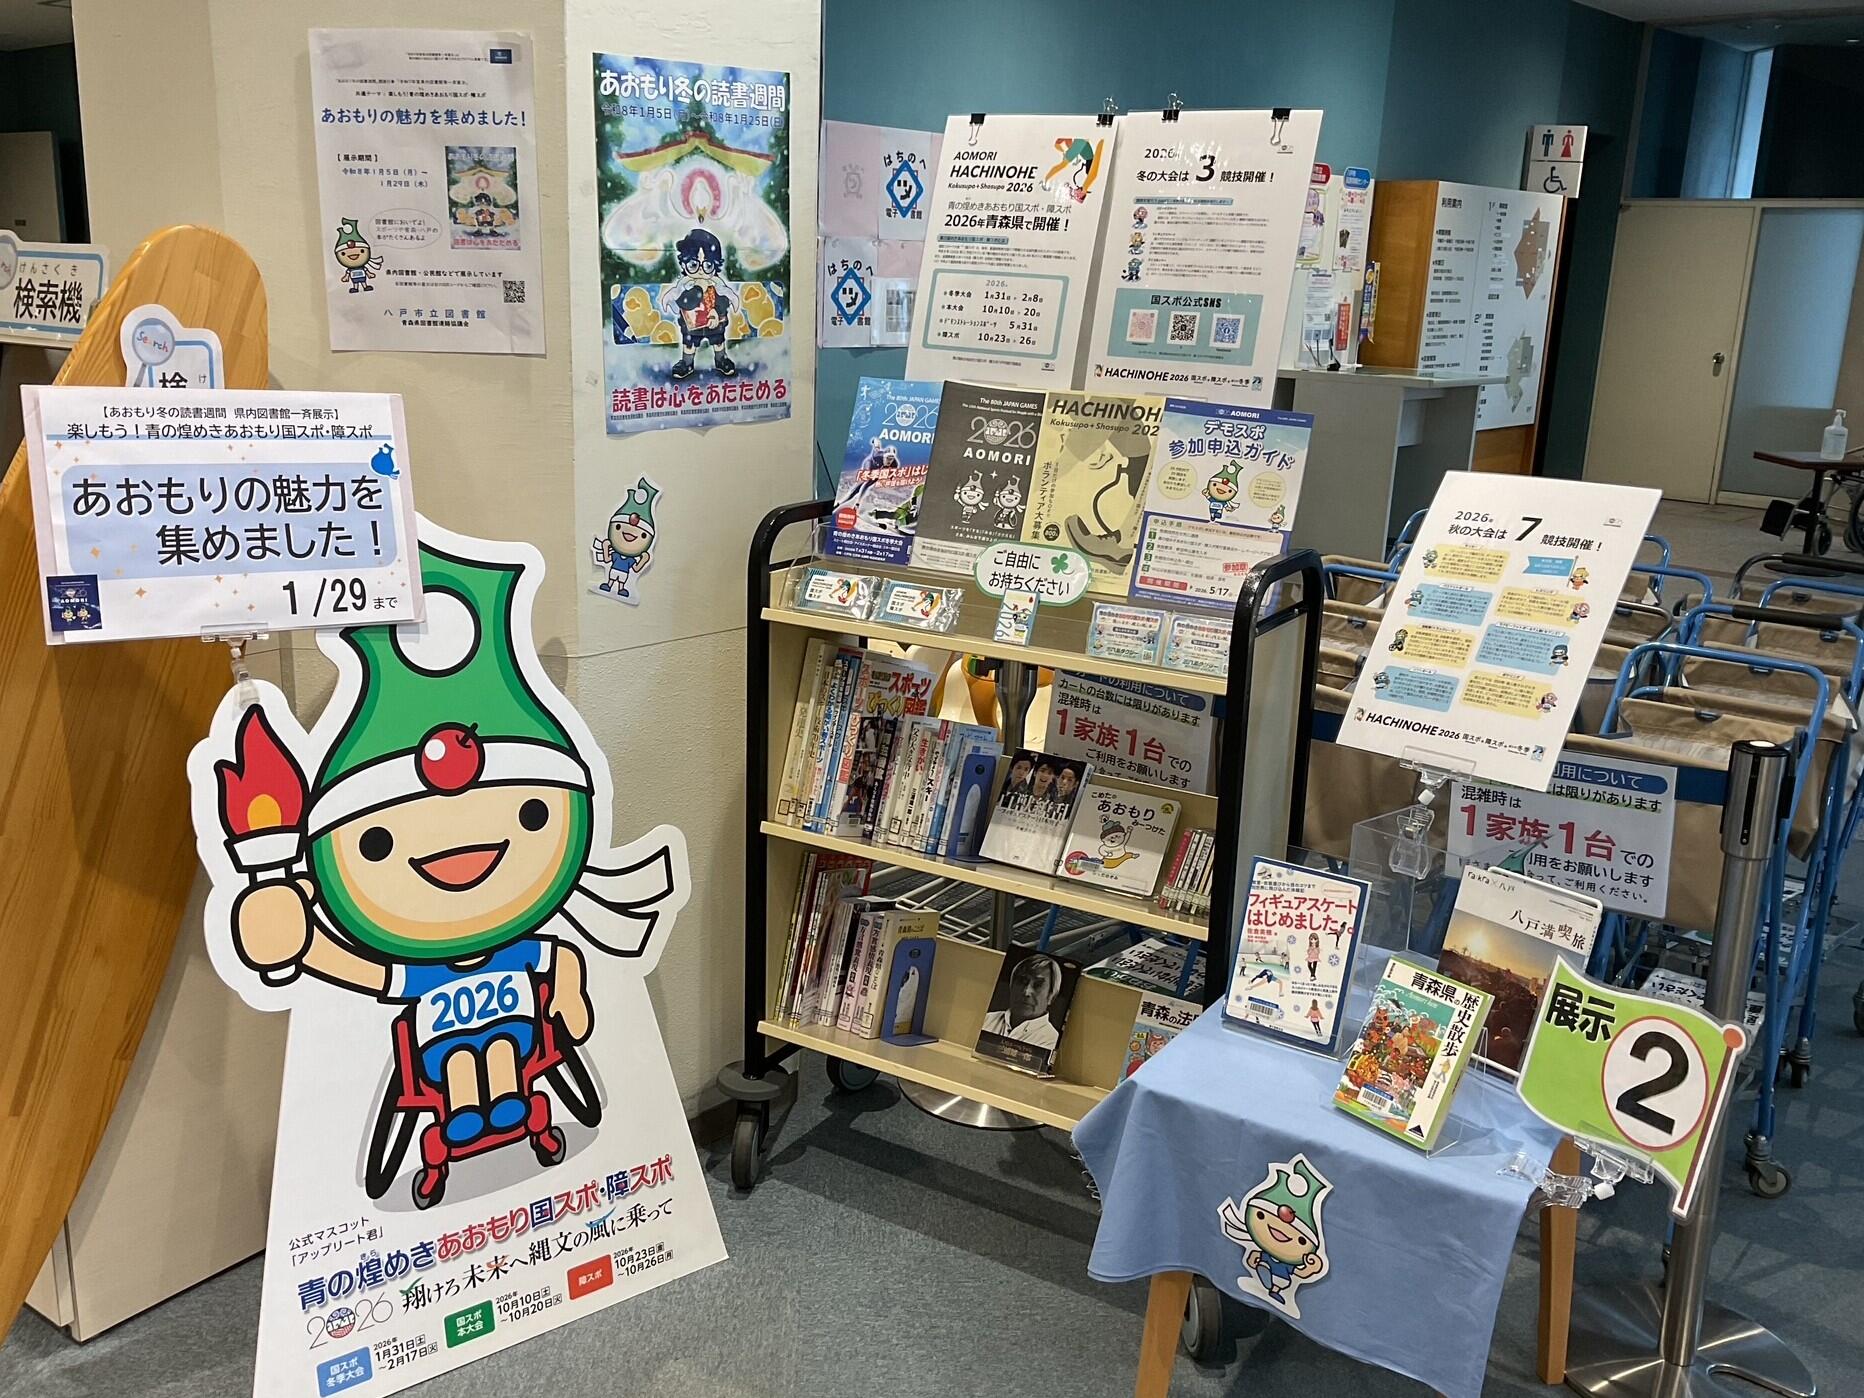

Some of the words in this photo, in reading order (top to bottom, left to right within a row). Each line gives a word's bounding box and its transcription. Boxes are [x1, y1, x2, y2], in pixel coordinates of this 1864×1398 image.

[600, 69, 786, 112] あおもり冬の読書週間
[321, 107, 526, 127] あおもりの魅力を集めました！
[883, 150, 927, 170] はちのへ
[953, 151, 998, 161] AOMORI
[949, 165, 1039, 180] HACHINOHE
[1136, 170, 1190, 182] 冬の大会は
[1195, 154, 1217, 182] 3
[1220, 171, 1274, 183] 競技開催！
[1006, 183, 1034, 193] 2026
[944, 214, 1070, 233] 2026年青森県で開催！
[827, 260, 874, 276] はちのへ
[13, 277, 82, 323] 検索機
[984, 291, 1011, 301] 1月31日
[1021, 294, 1044, 304] 2月8日
[1151, 295, 1222, 309] 国スポ公式SNS
[946, 304, 964, 312] 本大会
[982, 305, 1015, 315] 10月10日
[1023, 308, 1041, 318] 20日
[977, 332, 1011, 344] 10月23日
[1019, 336, 1037, 346] 26日
[1104, 367, 1170, 382] HACHINOHE
[1169, 373, 1189, 382] 2026
[612, 377, 787, 412] 読書は心をあたためる
[1003, 400, 1019, 408] JAPAN
[1019, 402, 1038, 410] GAMES
[101, 405, 227, 421] 【あおもり冬の読書週間
[233, 406, 341, 422] 県内図書館一斉展示】
[1051, 399, 1163, 422] HACHINOH
[1230, 411, 1260, 419] AOMORI
[67, 421, 374, 440] 楽しもう！青の煌めきあおもり国スポ・障スポ
[1204, 419, 1266, 440] デモスポ
[963, 447, 1032, 466] AOMORI
[1168, 438, 1296, 471] 参加申込ガイド
[72, 474, 384, 517] あおもりの魅力を
[156, 520, 383, 566] 集めました！
[1447, 524, 1508, 540] 秋の大会は
[1515, 516, 1543, 542] 7
[1539, 534, 1602, 552] 競技開催！
[993, 549, 1041, 570] ご自由に
[988, 571, 1070, 597] お持ちください
[372, 595, 399, 610] まで
[888, 671, 932, 699] スポーツ
[1057, 692, 1102, 715] 混雑時は
[1058, 678, 1201, 727] カートの台数には限りがあります
[1365, 712, 1440, 737] HACHINOHE
[1438, 729, 1460, 740] 2026
[1056, 708, 1166, 764] 1家族1台
[1168, 754, 1192, 773] での
[1085, 747, 1191, 789] ご利用をお願いします
[1461, 785, 1522, 809] 混雑時は
[1097, 799, 1156, 822] あおもり
[1131, 820, 1166, 836] みーつけた
[1459, 804, 1617, 862] 1家族1台
[1620, 849, 1655, 869] での
[1248, 893, 1359, 915] フィギュアスケート
[1247, 909, 1355, 935] はじめました。
[1509, 908, 1588, 952] 八戸満喫旅
[1410, 971, 1460, 1006] 青森県の
[430, 974, 519, 1032] 2026
[1140, 1001, 1200, 1026] 青森の法
[1545, 982, 1617, 1042] 展示
[1440, 992, 1481, 1058] 歴史散歩
[1615, 1031, 1690, 1136] 2
[288, 1216, 371, 1252] 公式マスコット
[297, 1154, 674, 1312] 青の煌めきあおもり国スポ・障スポ
[291, 1227, 384, 1268] 「アップリート君」
[613, 1246, 634, 1259] 2026年
[578, 1269, 603, 1286] 障スポ
[496, 1290, 518, 1303] 2026年
[456, 1309, 482, 1327] 国スポ
[456, 1320, 484, 1337] 本大会
[373, 1336, 398, 1351] 2026年
[326, 1368, 365, 1387] 冬季大会
[330, 1357, 359, 1376] 国スポ
